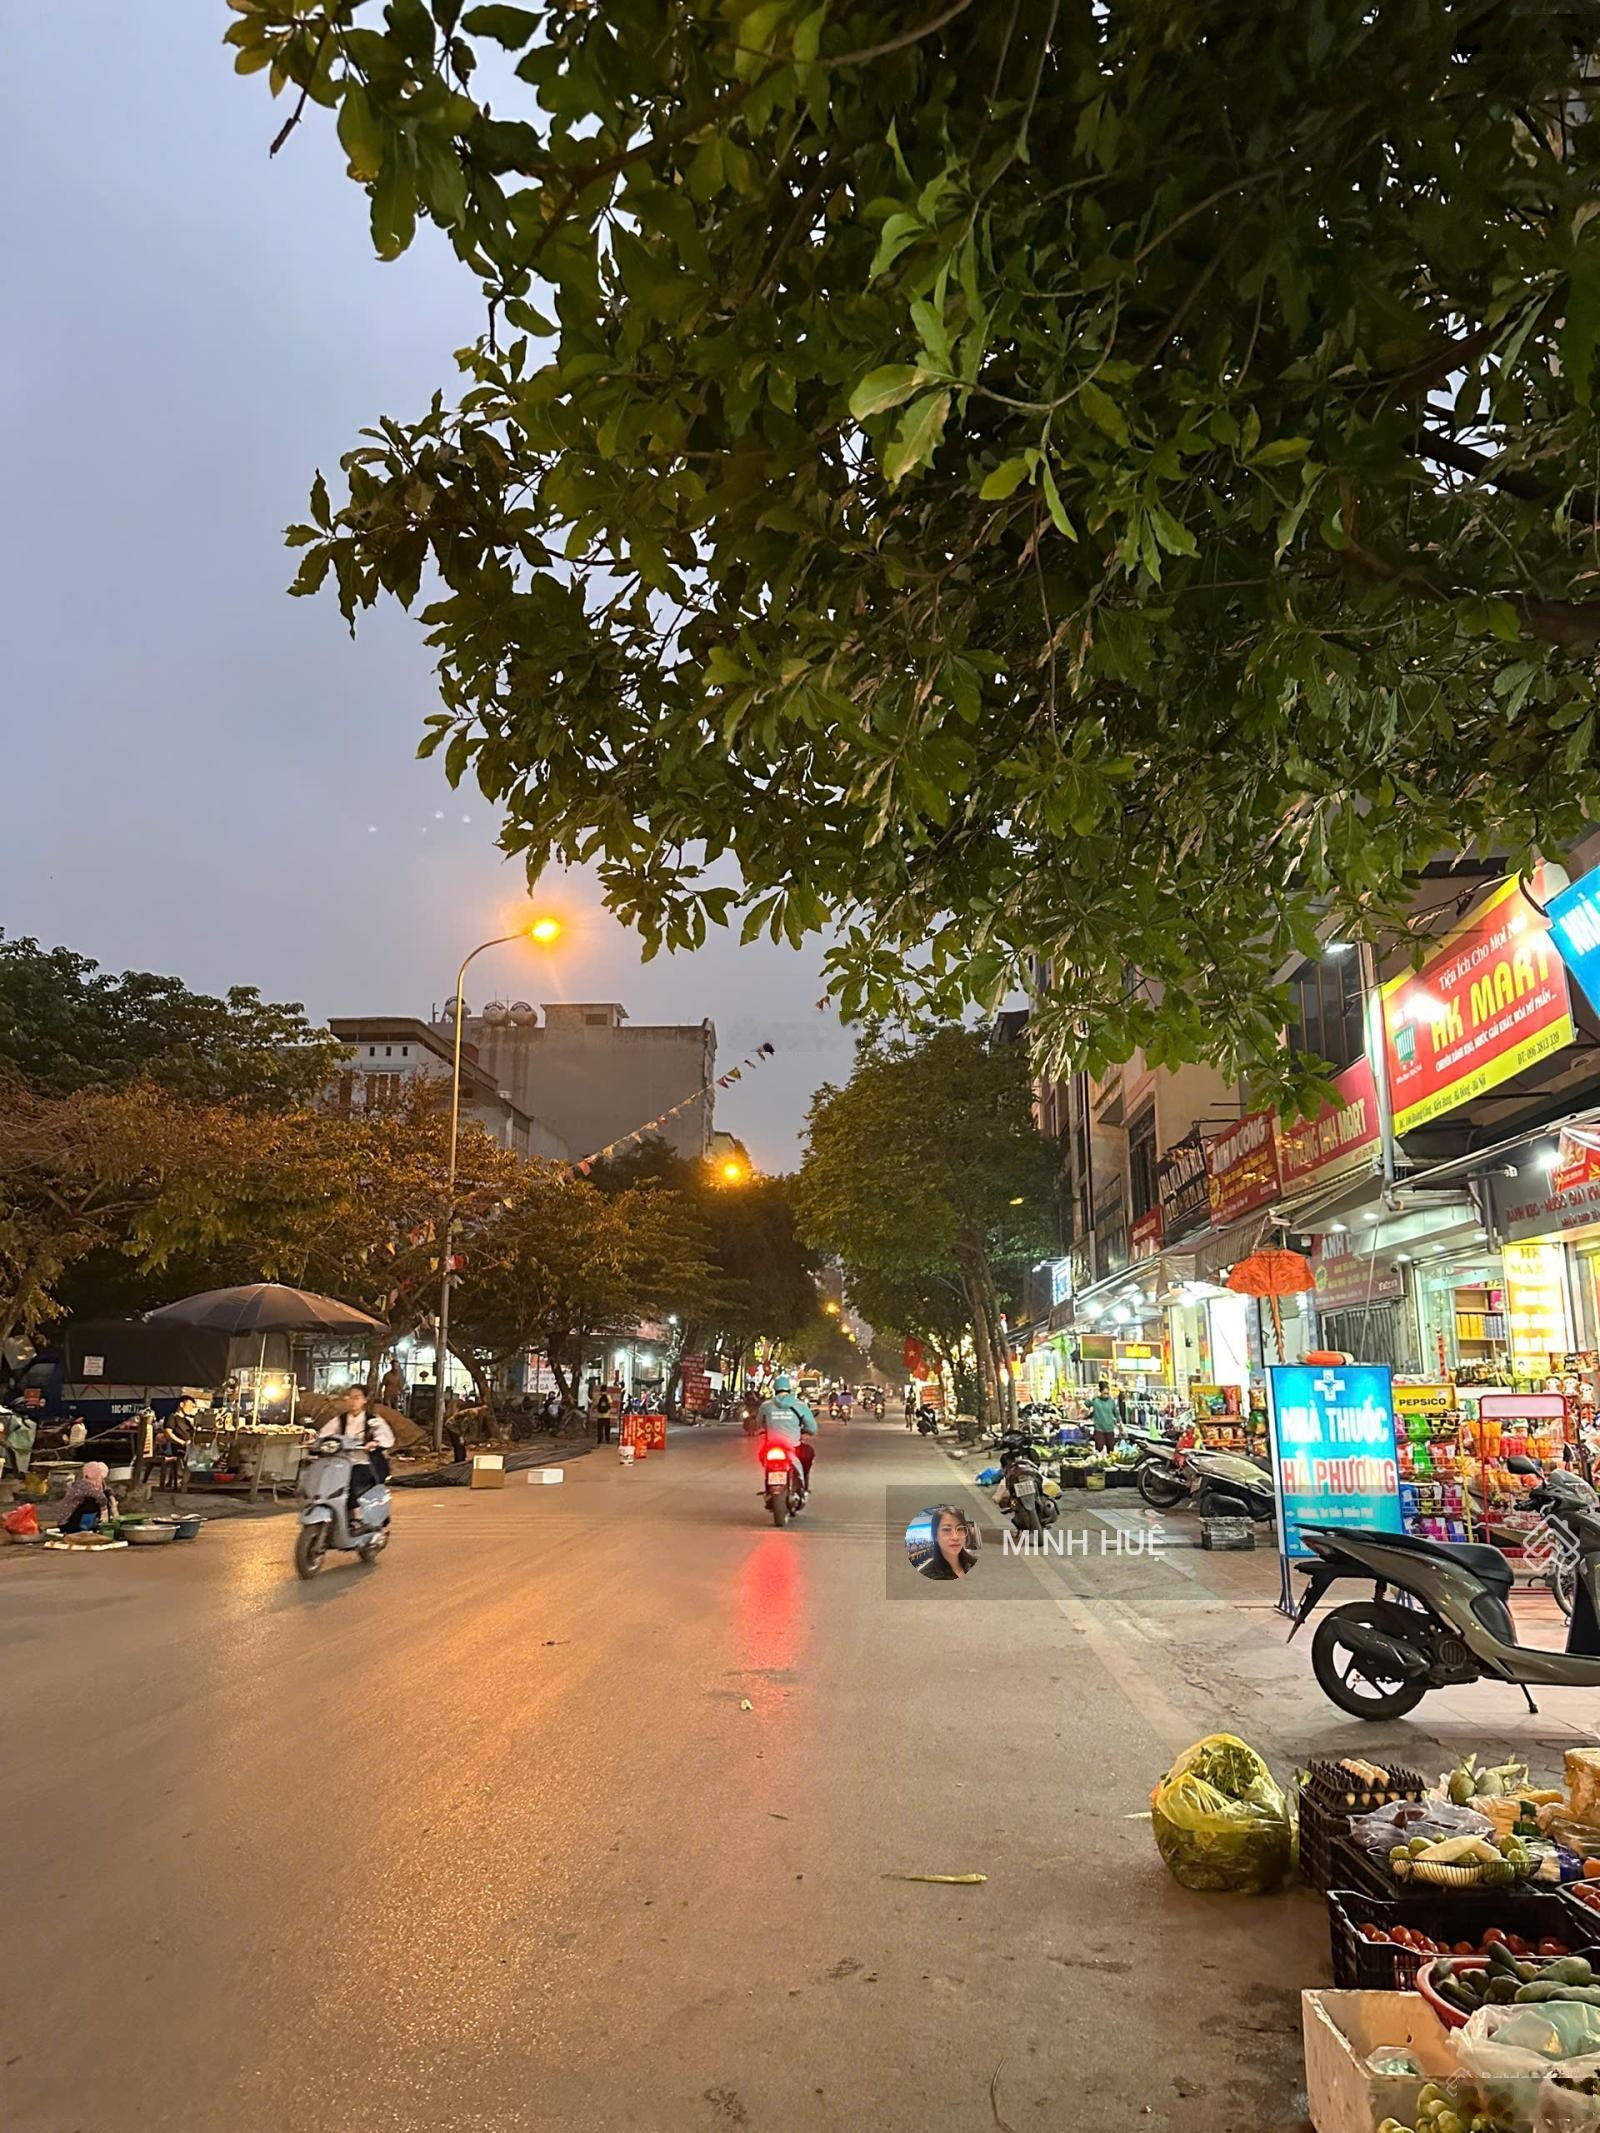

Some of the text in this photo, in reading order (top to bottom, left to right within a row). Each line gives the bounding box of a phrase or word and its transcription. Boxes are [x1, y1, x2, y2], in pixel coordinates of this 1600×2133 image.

[1471, 944, 1489, 966] Cho
[1470, 938, 1549, 1028] MART
[1338, 1098, 1366, 1145] MART
[1281, 1396, 1389, 1443] NHÀ THUỐC
[1399, 1397, 1447, 1406] PEPSICO
[1316, 1457, 1396, 1495] PHƯƠNG
